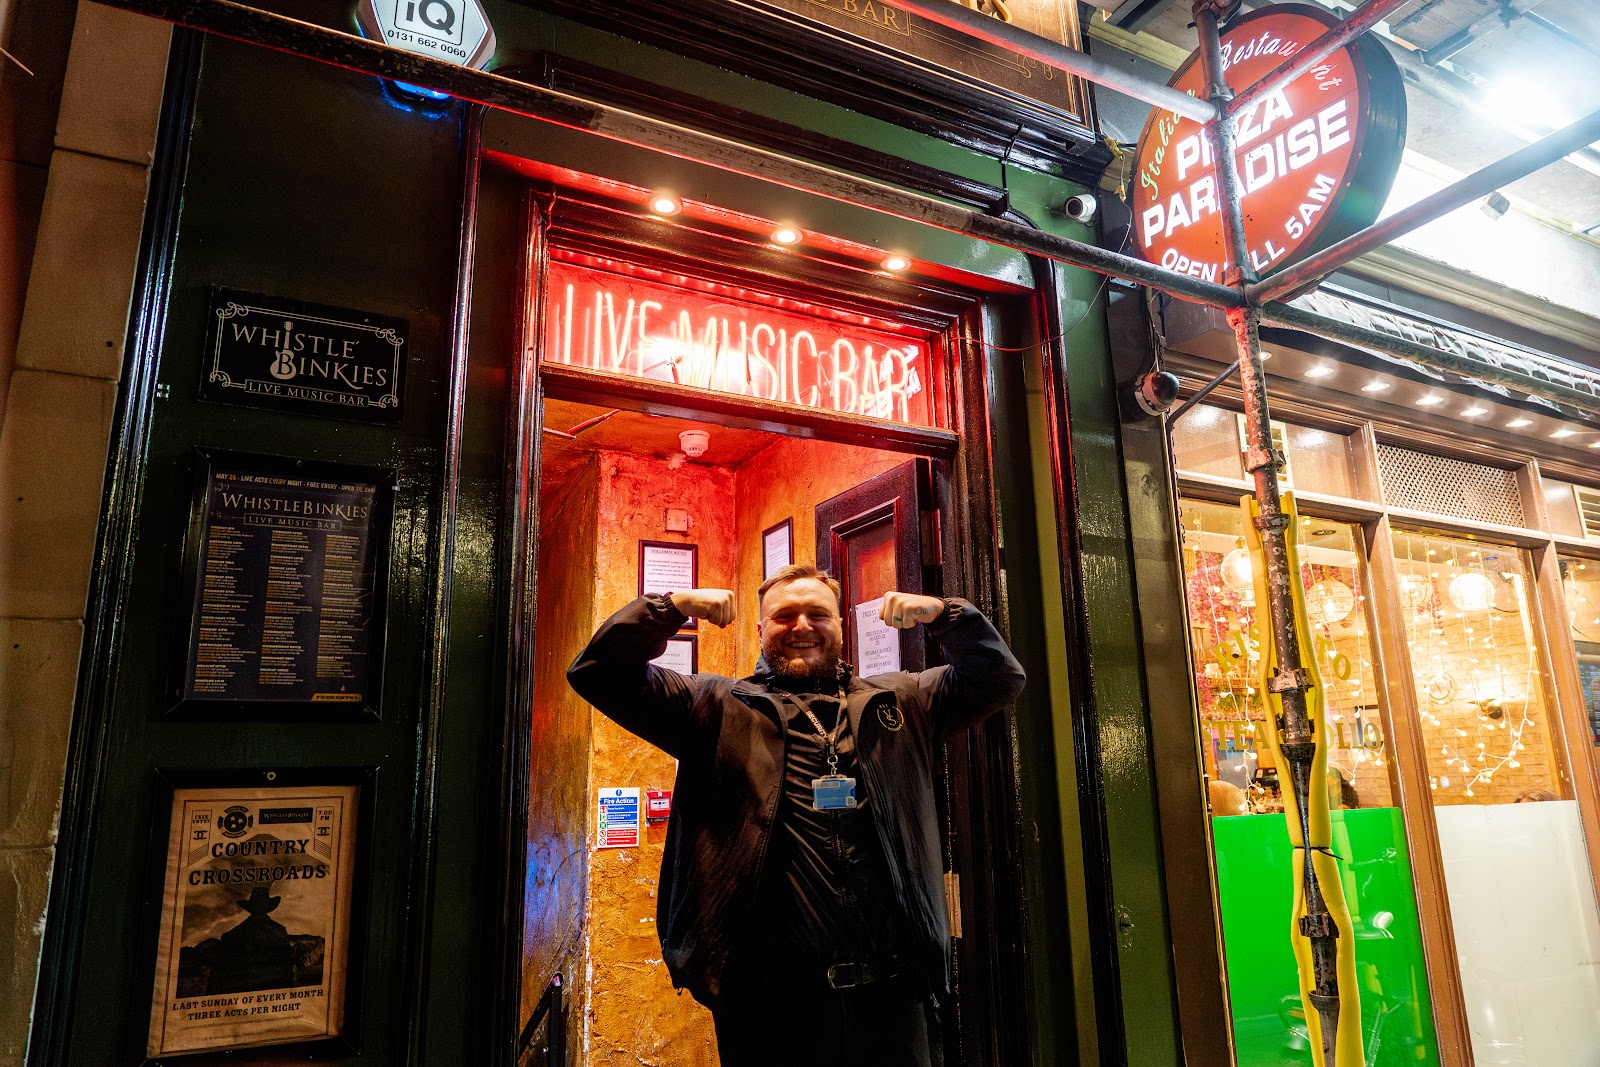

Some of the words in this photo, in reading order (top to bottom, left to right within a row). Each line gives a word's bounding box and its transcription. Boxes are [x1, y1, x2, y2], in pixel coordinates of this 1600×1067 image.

[843, 0, 901, 31] BAR
[387, 29, 414, 43] 0131
[417, 37, 437, 49] 662
[440, 43, 466, 58] 0060
[1220, 31, 1343, 91] Restaunt
[1176, 88, 1295, 181] PIZA
[1161, 248, 1218, 283] OPEN
[1285, 173, 1337, 240] 5AM
[565, 283, 662, 378] LIVE
[679, 309, 820, 408] MUSIC
[832, 337, 909, 423] BAR
[271, 350, 388, 391] BINKIES
[248, 381, 282, 396] LIVE
[287, 387, 334, 403] MUSIC
[339, 394, 365, 406] BAR
[269, 477, 286, 485] EVERY
[222, 492, 368, 521] WHISTLEBINKIES
[249, 515, 273, 524] LIVE
[278, 518, 313, 527] MUSIC
[317, 521, 337, 530] BAR
[806, 711, 828, 739] SECURITY
[211, 839, 310, 859] COUNTRY
[188, 864, 327, 886] CROSSROADS
[173, 1001, 199, 1011] LAST
[201, 998, 239, 1008] SUNDAY
[242, 996, 254, 1005] OF
[257, 992, 287, 1003] EVERY
[289, 988, 324, 1000] MONTH
[188, 1010, 221, 1021] THREE
[224, 1008, 249, 1018] ACTS
[251, 1006, 269, 1015] PER
[272, 1002, 302, 1013] NIGHT
